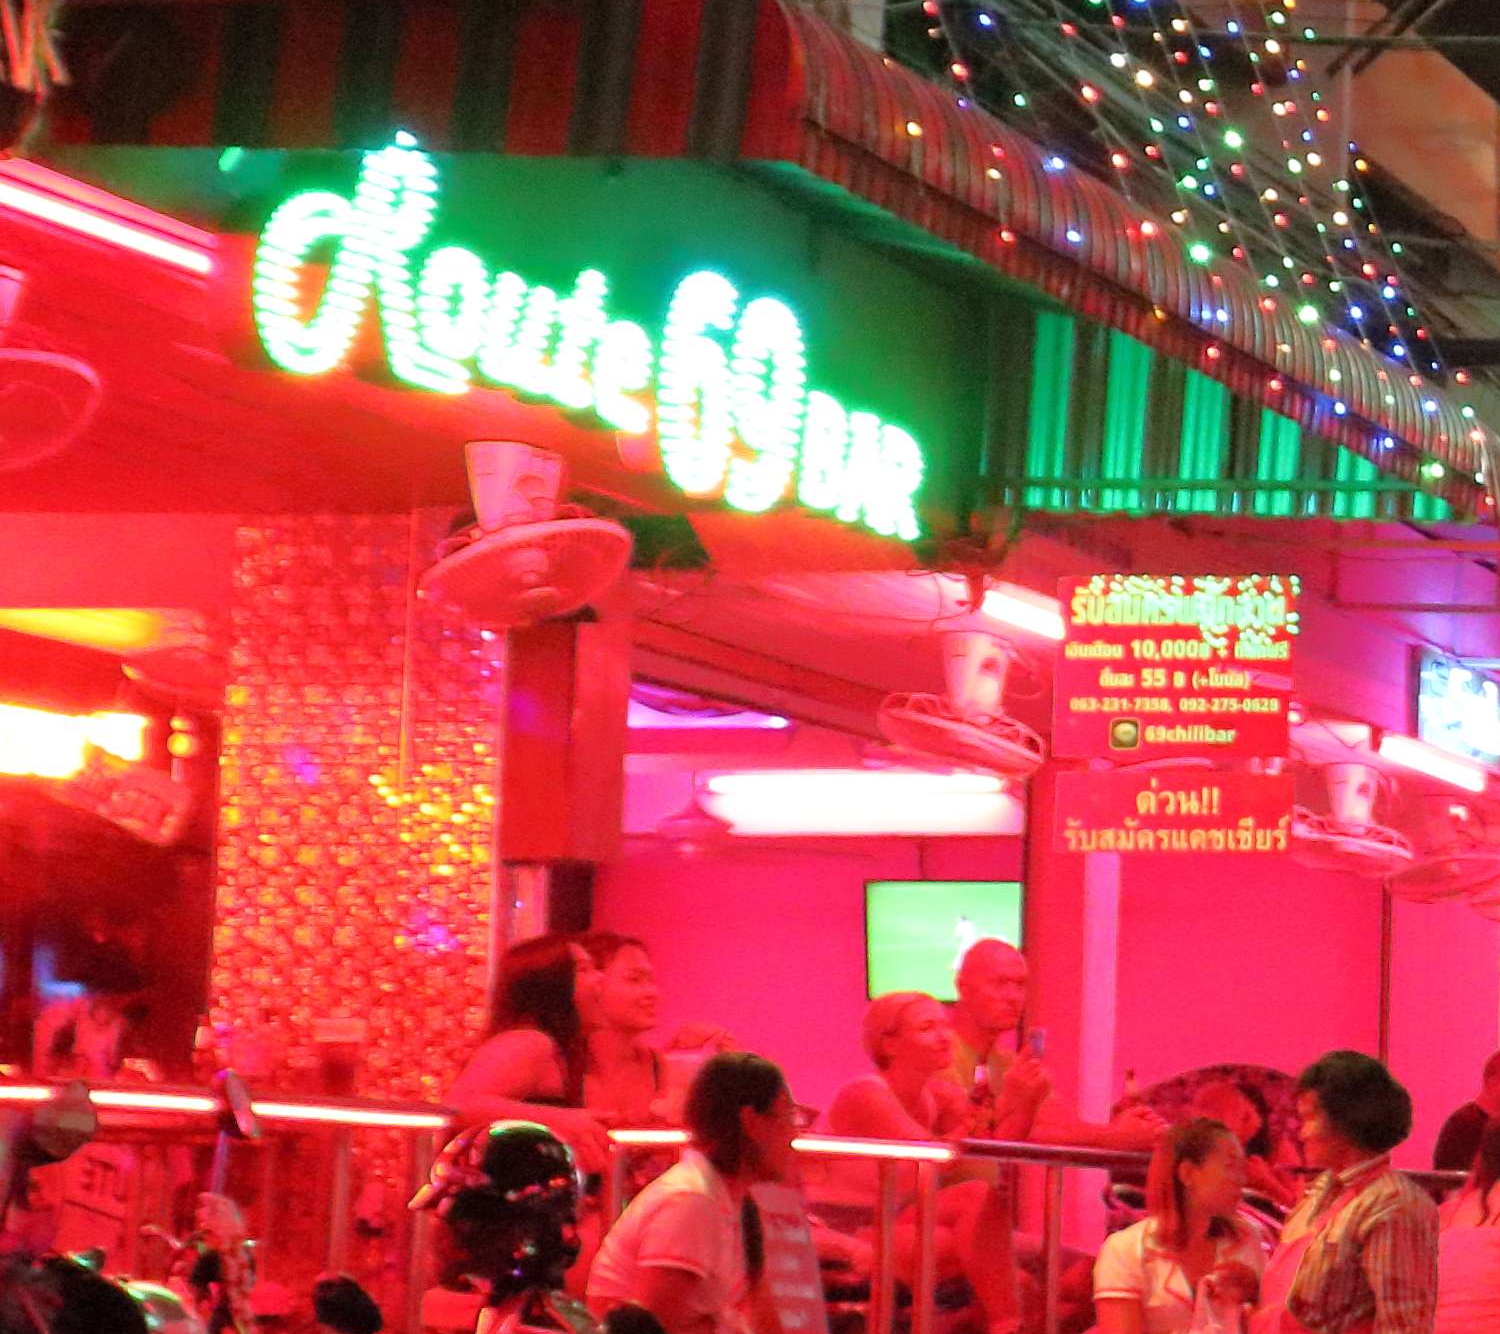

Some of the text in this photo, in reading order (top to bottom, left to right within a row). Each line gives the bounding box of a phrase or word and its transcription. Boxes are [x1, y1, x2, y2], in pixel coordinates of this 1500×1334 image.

[254, 129, 653, 435] Route
[659, 269, 806, 512] 69
[1140, 666, 1168, 688] 55
[1136, 777, 1222, 816] ด่วน!!
